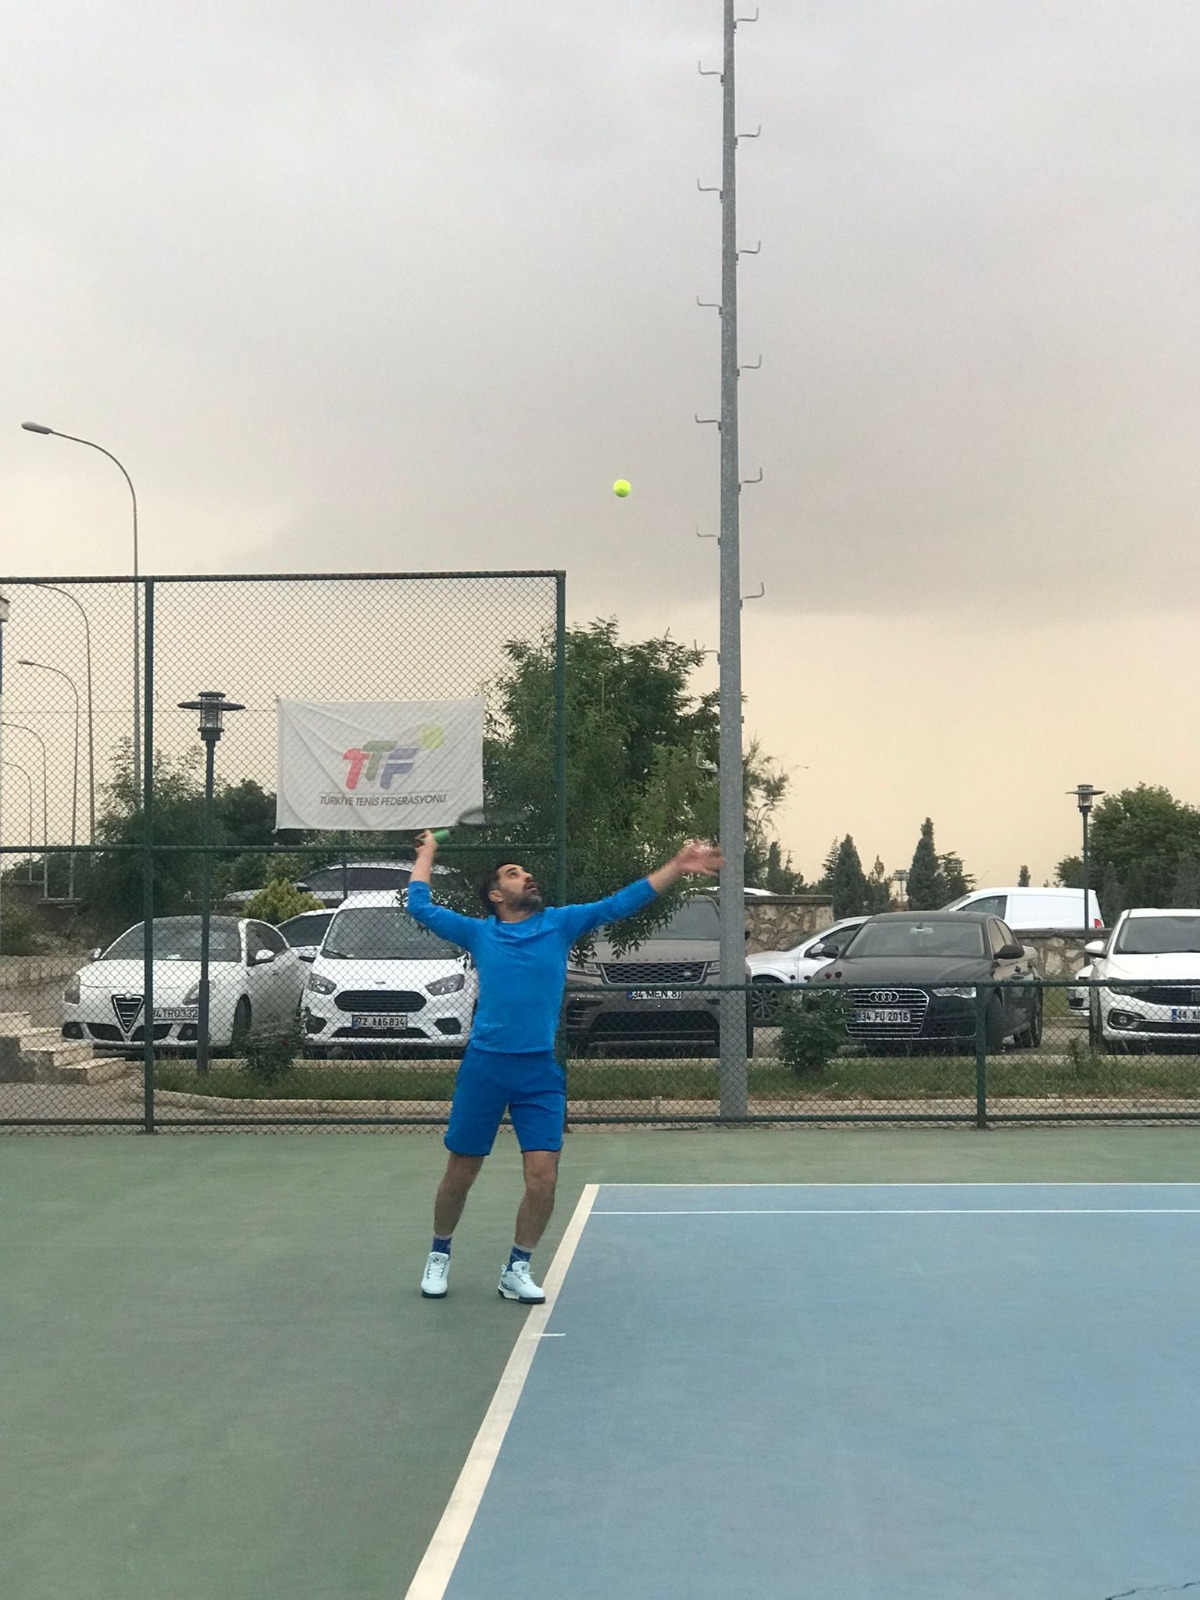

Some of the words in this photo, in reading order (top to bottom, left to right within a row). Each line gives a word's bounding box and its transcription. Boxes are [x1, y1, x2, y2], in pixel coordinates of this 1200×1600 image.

[342, 740, 419, 790] TTF
[320, 793, 354, 806] TÜRKİYE
[381, 794, 447, 806] FEDERASYONU
